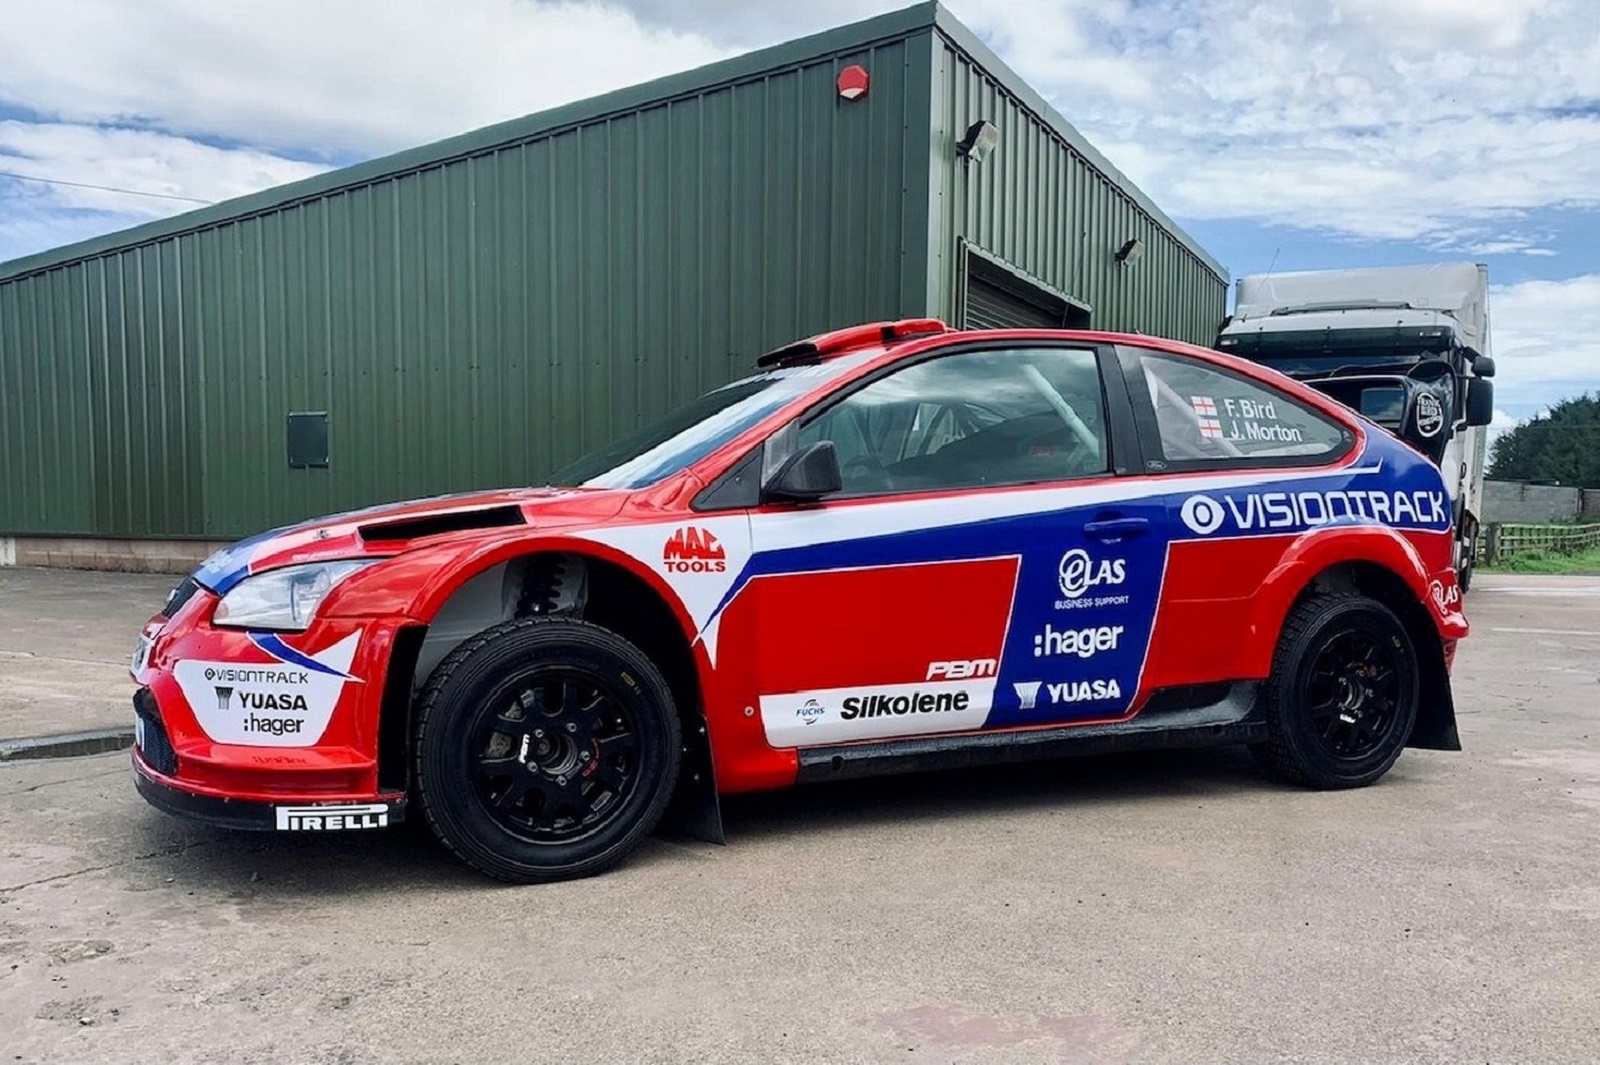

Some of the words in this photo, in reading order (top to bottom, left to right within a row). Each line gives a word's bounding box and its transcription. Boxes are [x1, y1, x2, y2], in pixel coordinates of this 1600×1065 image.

[1224, 399, 1239, 418] F.
[1241, 400, 1277, 419] Bird
[1231, 420, 1245, 439] J.
[1245, 422, 1303, 441] Morton
[1224, 490, 1446, 529] VISIONTRACK
[664, 527, 725, 559] MAC
[664, 561, 725, 573] TOOLS
[1055, 598, 1093, 609] BUSINESS
[1095, 596, 1129, 607] SUPPORT
[216, 669, 308, 684] VISIONTRACK
[239, 691, 308, 711] YUASA
[1047, 678, 1121, 704] YUASA
[796, 707, 826, 717] FUCHS
[841, 690, 969, 720] Silkolene
[276, 804, 389, 831] PIRELLI
